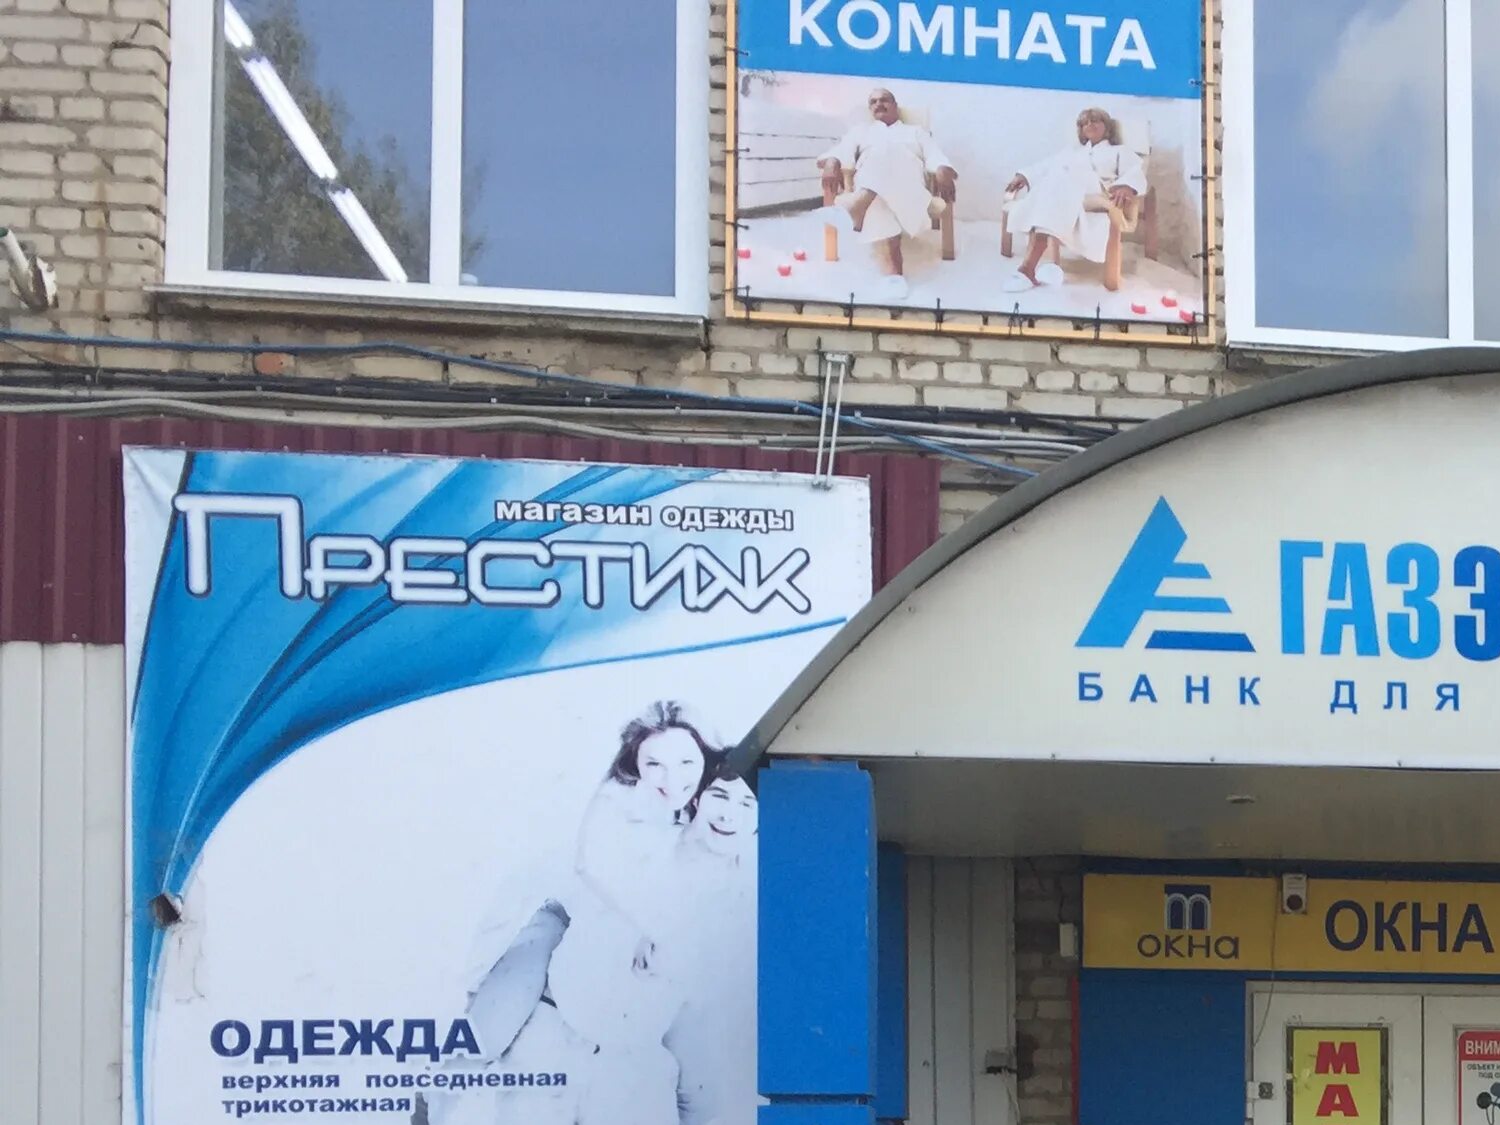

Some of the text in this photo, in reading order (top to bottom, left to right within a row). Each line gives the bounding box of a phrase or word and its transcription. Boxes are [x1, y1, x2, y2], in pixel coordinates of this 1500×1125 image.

[788, 0, 1157, 70] КОМНАТА
[495, 499, 652, 526] магазин
[1076, 672, 1262, 706] БАНК
[1330, 681, 1462, 716] ДЛЯ
[1324, 899, 1496, 955] ОКНА
[1137, 934, 1240, 960] окна
[209, 1018, 481, 1064] ОДЕЖДА
[221, 1070, 568, 1093] верхняя повседневная
[221, 1095, 412, 1118] трикотажная
